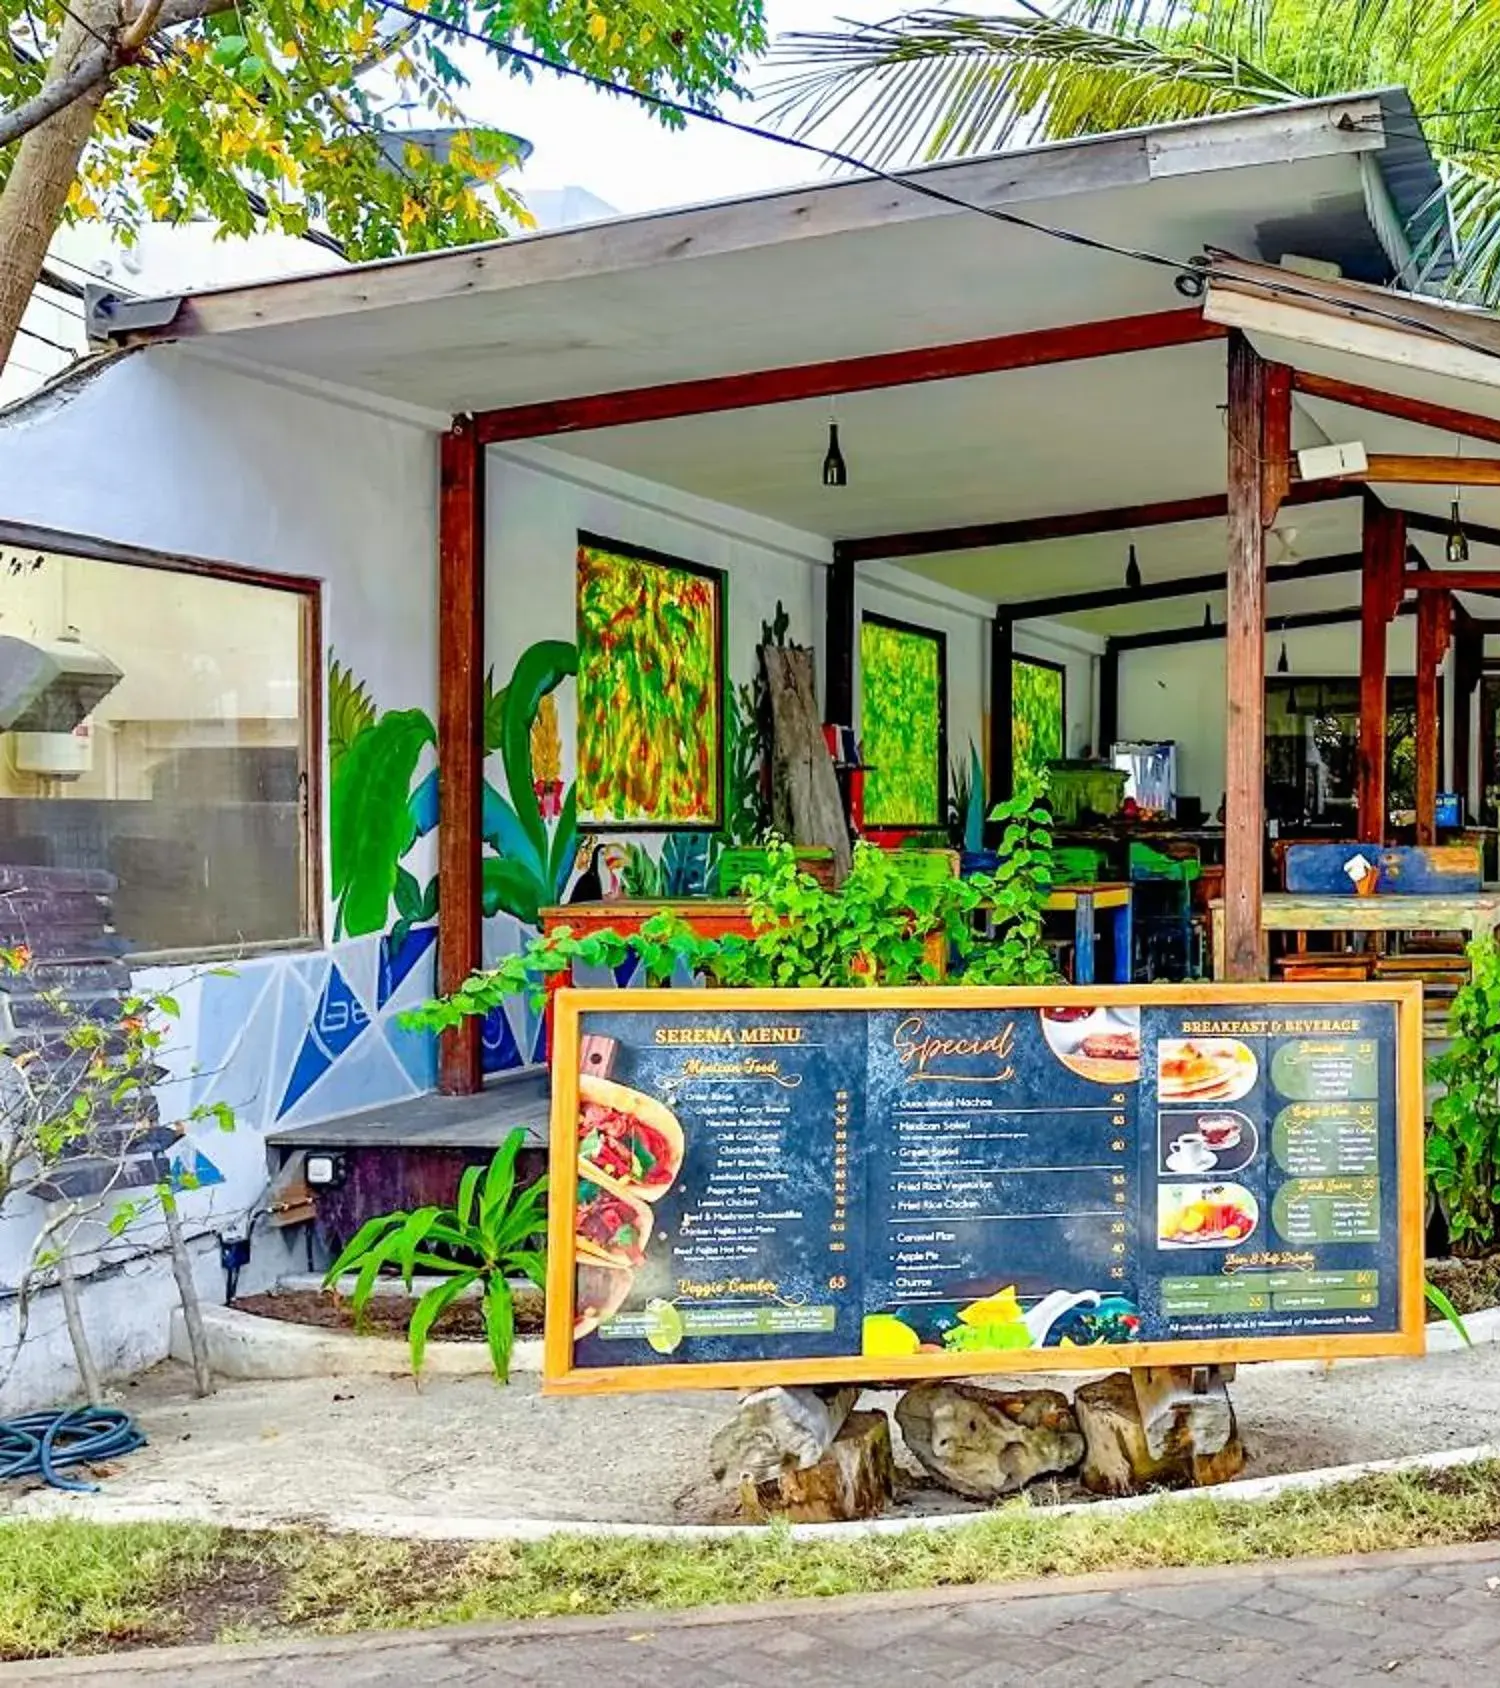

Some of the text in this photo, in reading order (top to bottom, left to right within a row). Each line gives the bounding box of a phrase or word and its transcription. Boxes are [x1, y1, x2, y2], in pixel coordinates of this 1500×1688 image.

[1182, 1020, 1269, 1034] BREAKFAST
[1285, 1019, 1361, 1032] BEVERAGE
[655, 1027, 801, 1043] SERENA MENU
[893, 1017, 1015, 1074] Special
[744, 1057, 779, 1074] Food
[955, 1097, 993, 1108] Nachos
